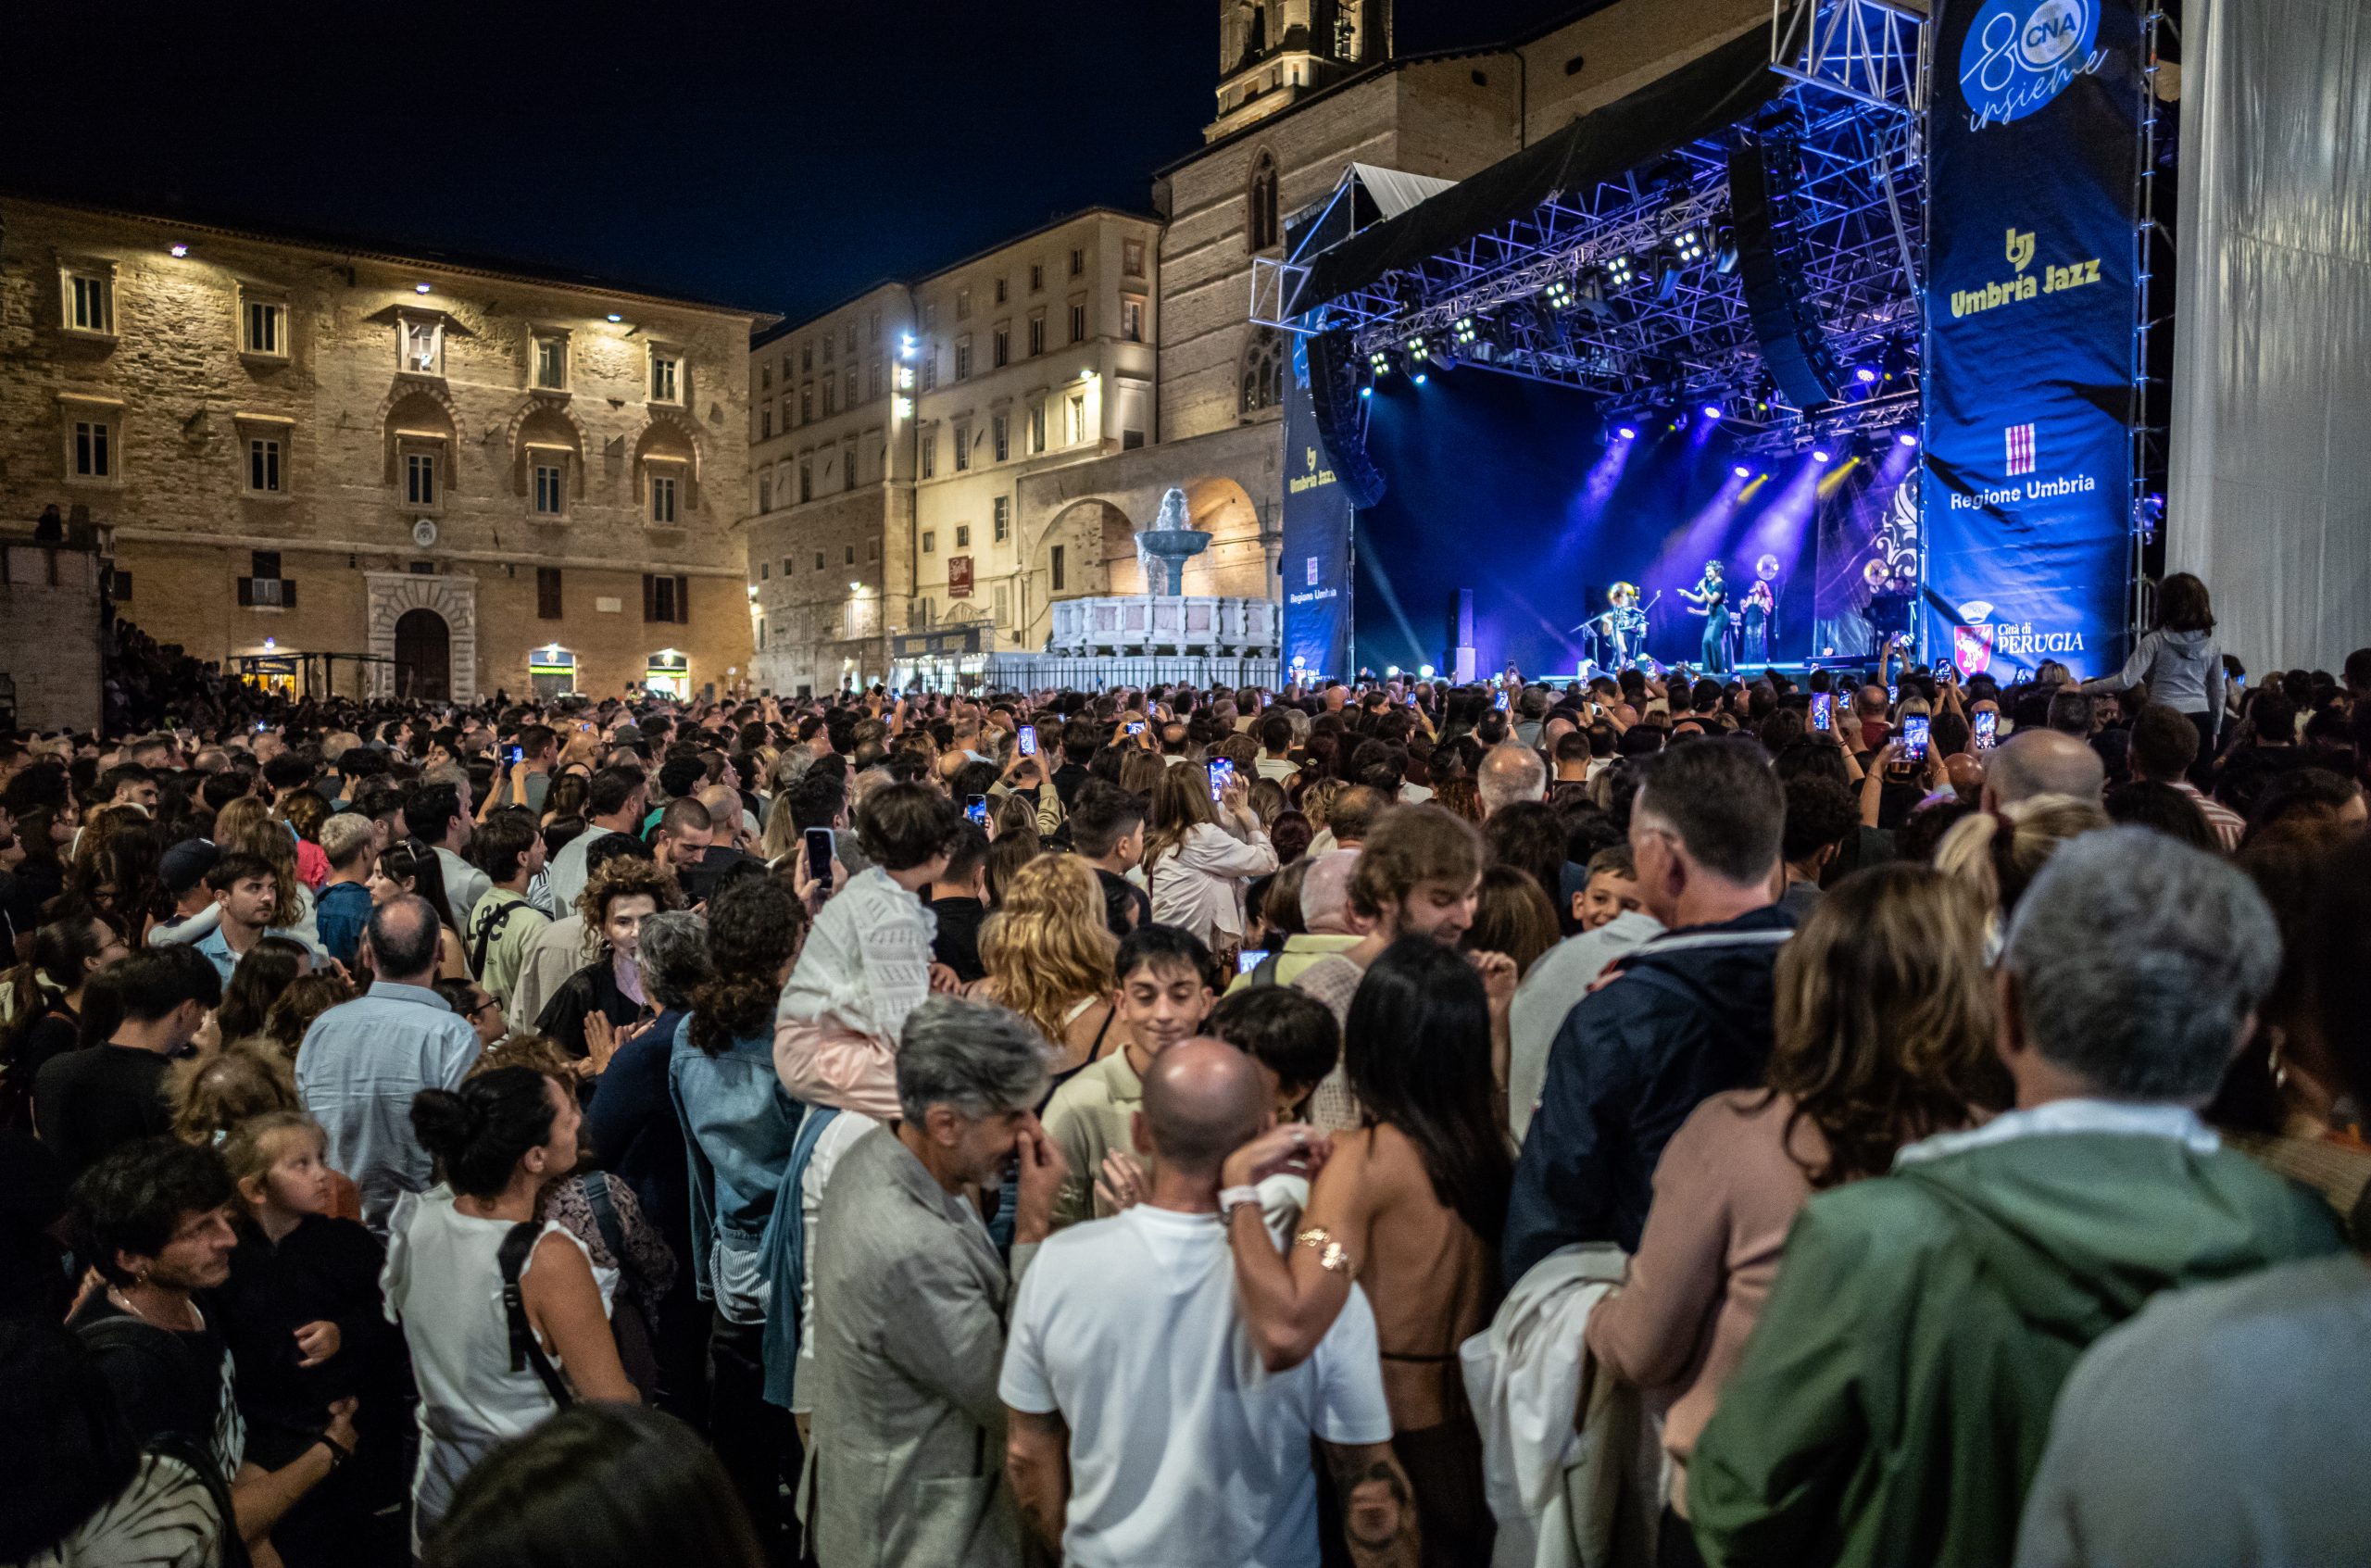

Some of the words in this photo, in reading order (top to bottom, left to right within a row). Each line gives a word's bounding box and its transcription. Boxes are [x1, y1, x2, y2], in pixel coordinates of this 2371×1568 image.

[2026, 13, 2076, 47] CNA
[1970, 49, 2109, 132] insieme
[1951, 274, 2038, 318] Umbria
[2043, 258, 2101, 294] Jazz
[1951, 488, 2021, 509] Regione
[2026, 473, 2095, 499] Umbria
[1997, 632, 2084, 654] PERUGIA
[1998, 624, 2019, 635] Città
[2021, 621, 2032, 634] di
